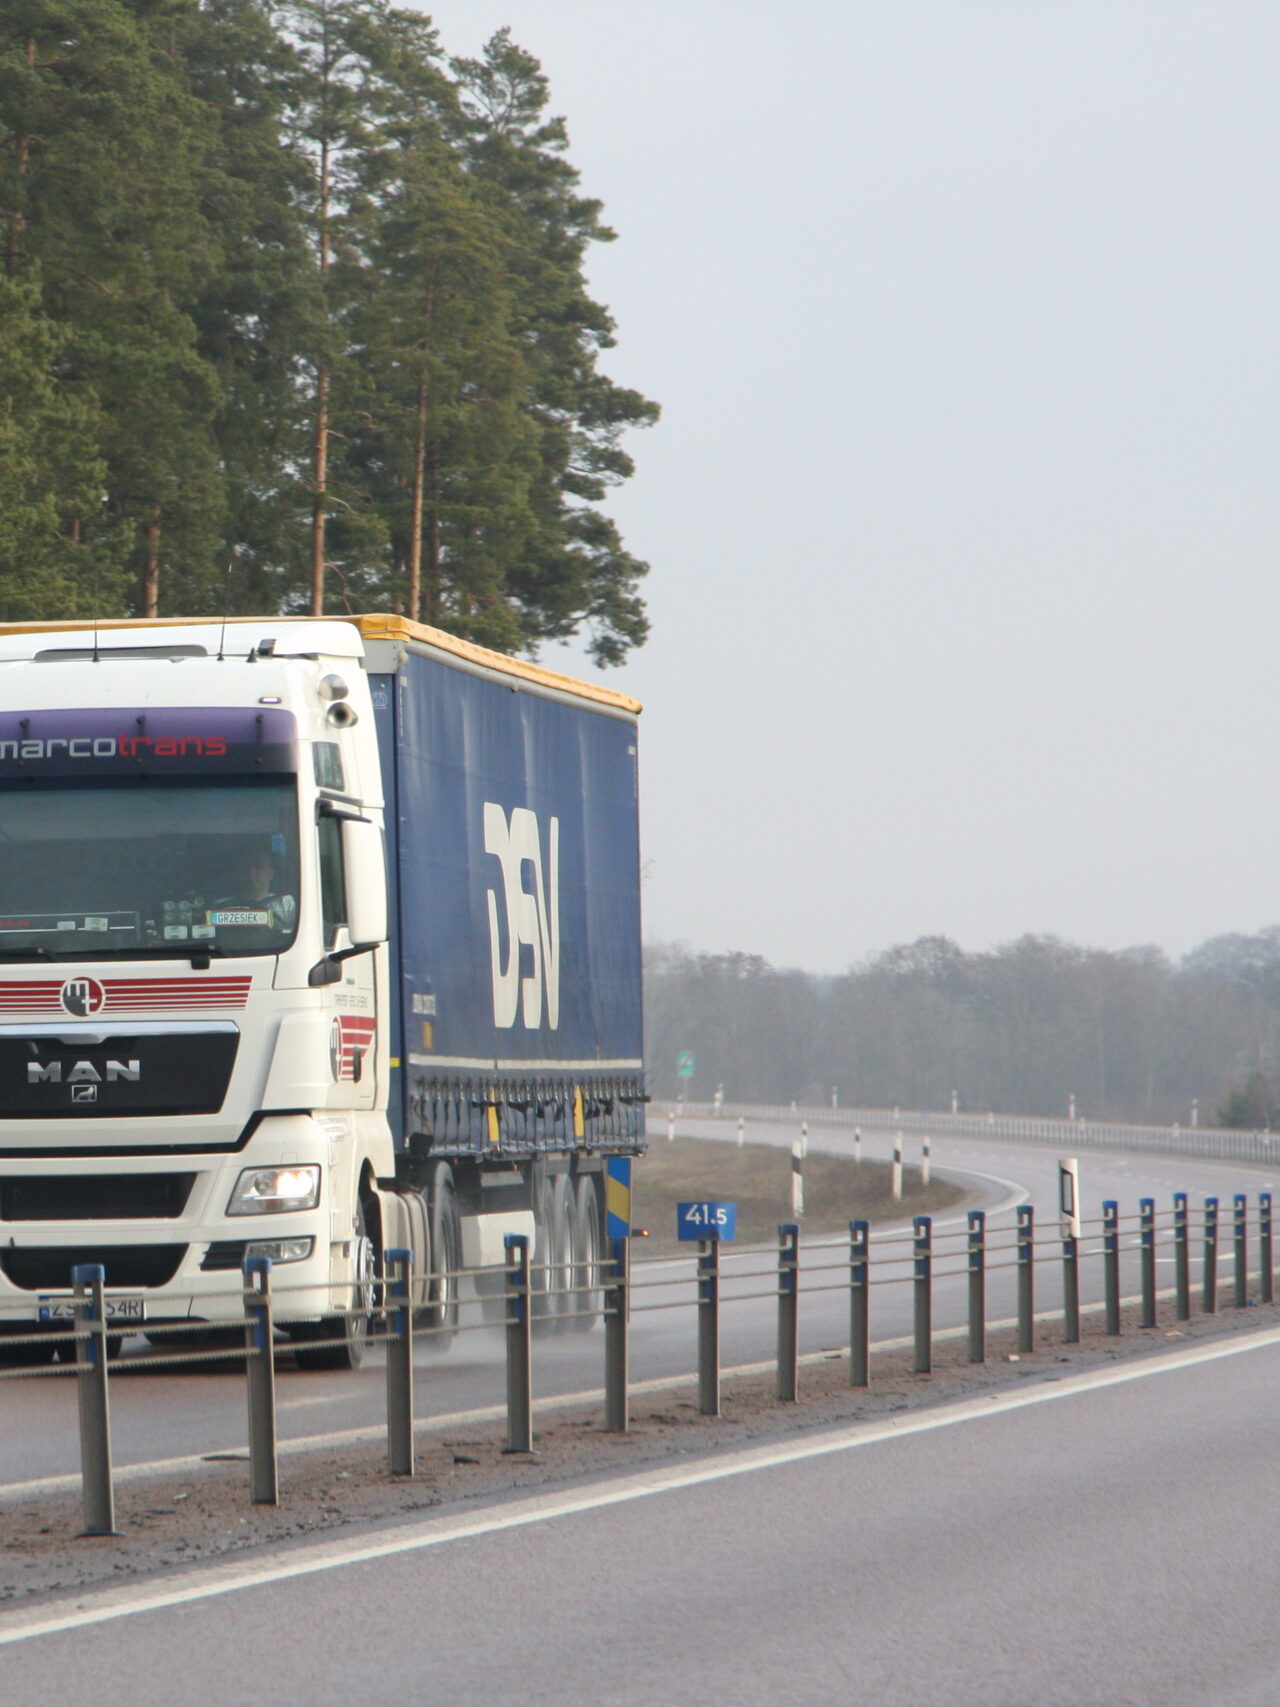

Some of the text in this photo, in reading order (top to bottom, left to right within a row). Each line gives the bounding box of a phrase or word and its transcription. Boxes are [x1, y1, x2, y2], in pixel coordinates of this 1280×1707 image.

[217, 913, 258, 923] GRZESIEK
[483, 801, 560, 1030] DSV
[27, 1059, 141, 1083] MAN
[685, 1203, 728, 1226] 41.5
